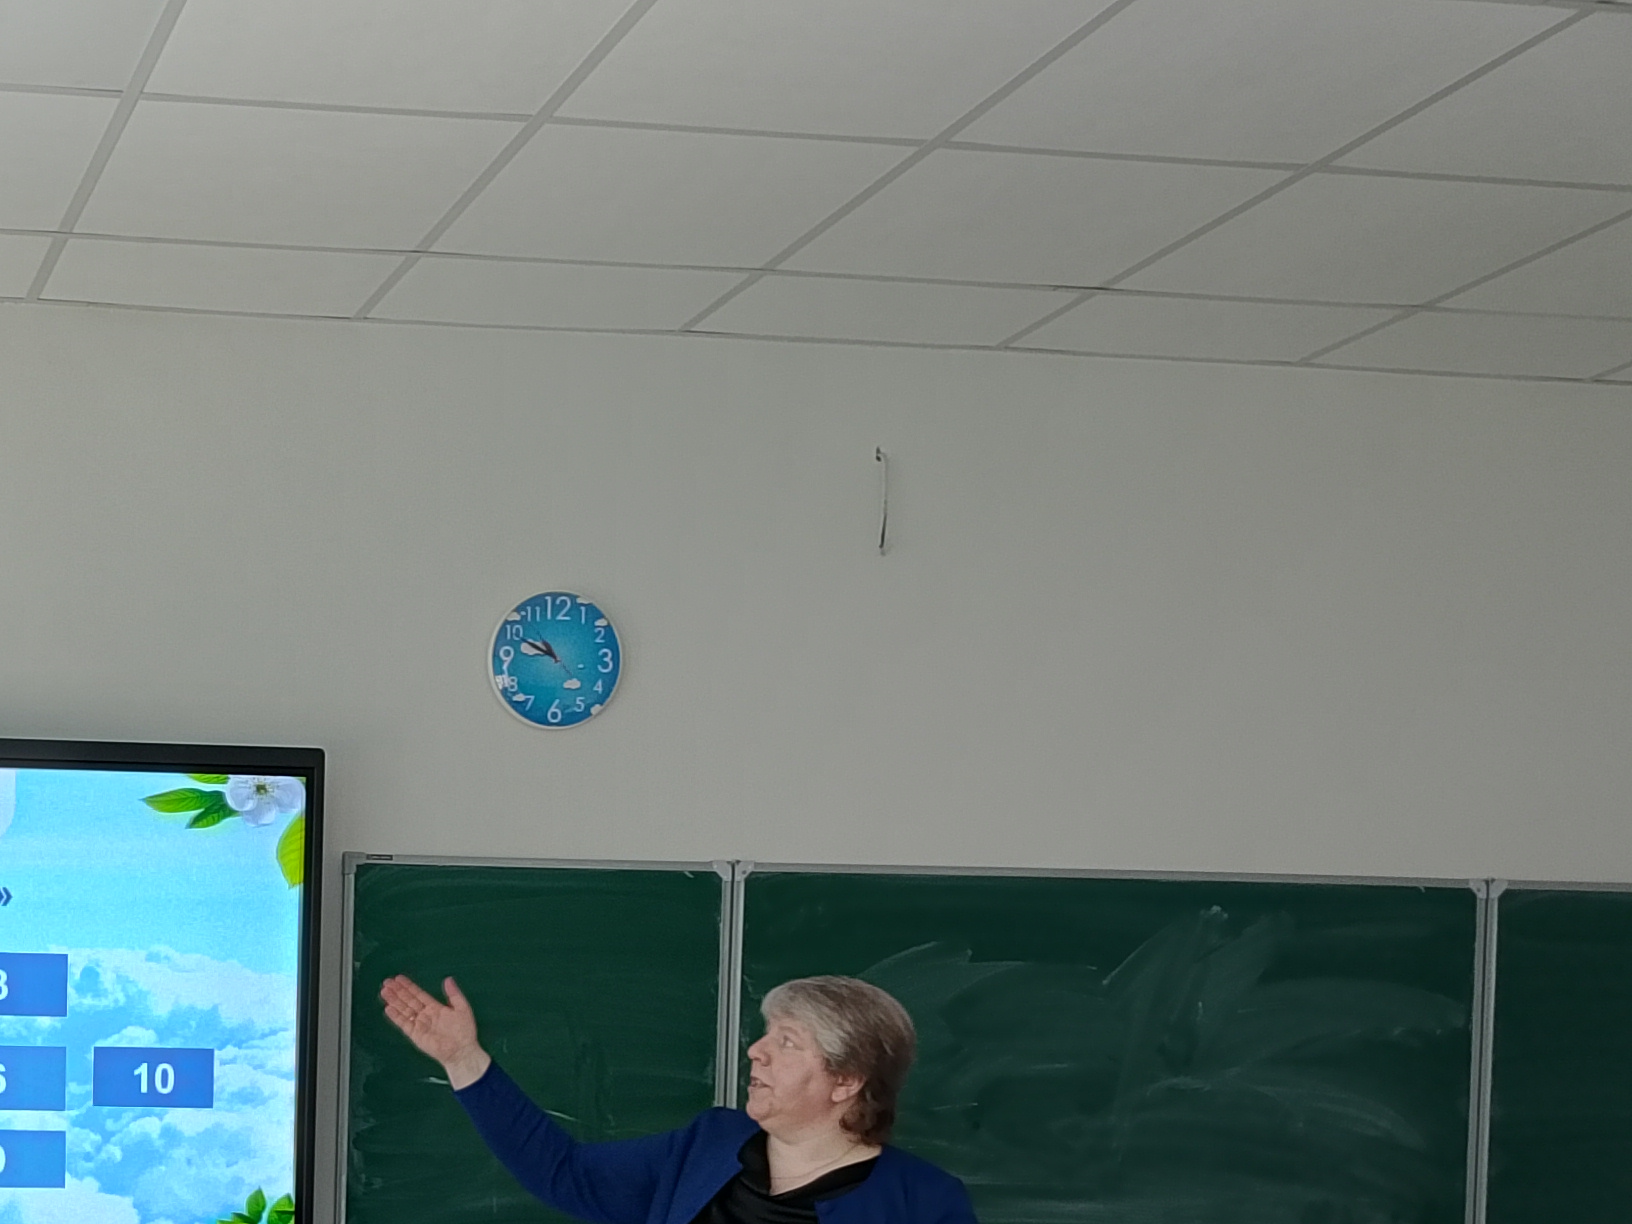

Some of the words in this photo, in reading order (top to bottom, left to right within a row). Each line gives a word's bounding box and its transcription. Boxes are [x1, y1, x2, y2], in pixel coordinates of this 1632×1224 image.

[525, 606, 541, 622] 11
[544, 596, 572, 620] 12
[579, 606, 587, 625] 1
[505, 624, 523, 641] 10
[593, 627, 606, 643] 2
[499, 645, 515, 677] 9
[597, 648, 614, 673] 3
[507, 676, 519, 692] 8
[593, 679, 603, 695] 4
[523, 695, 536, 711] 7
[546, 698, 563, 723] 6
[574, 696, 586, 712] 5
[134, 1062, 175, 1094] 10
